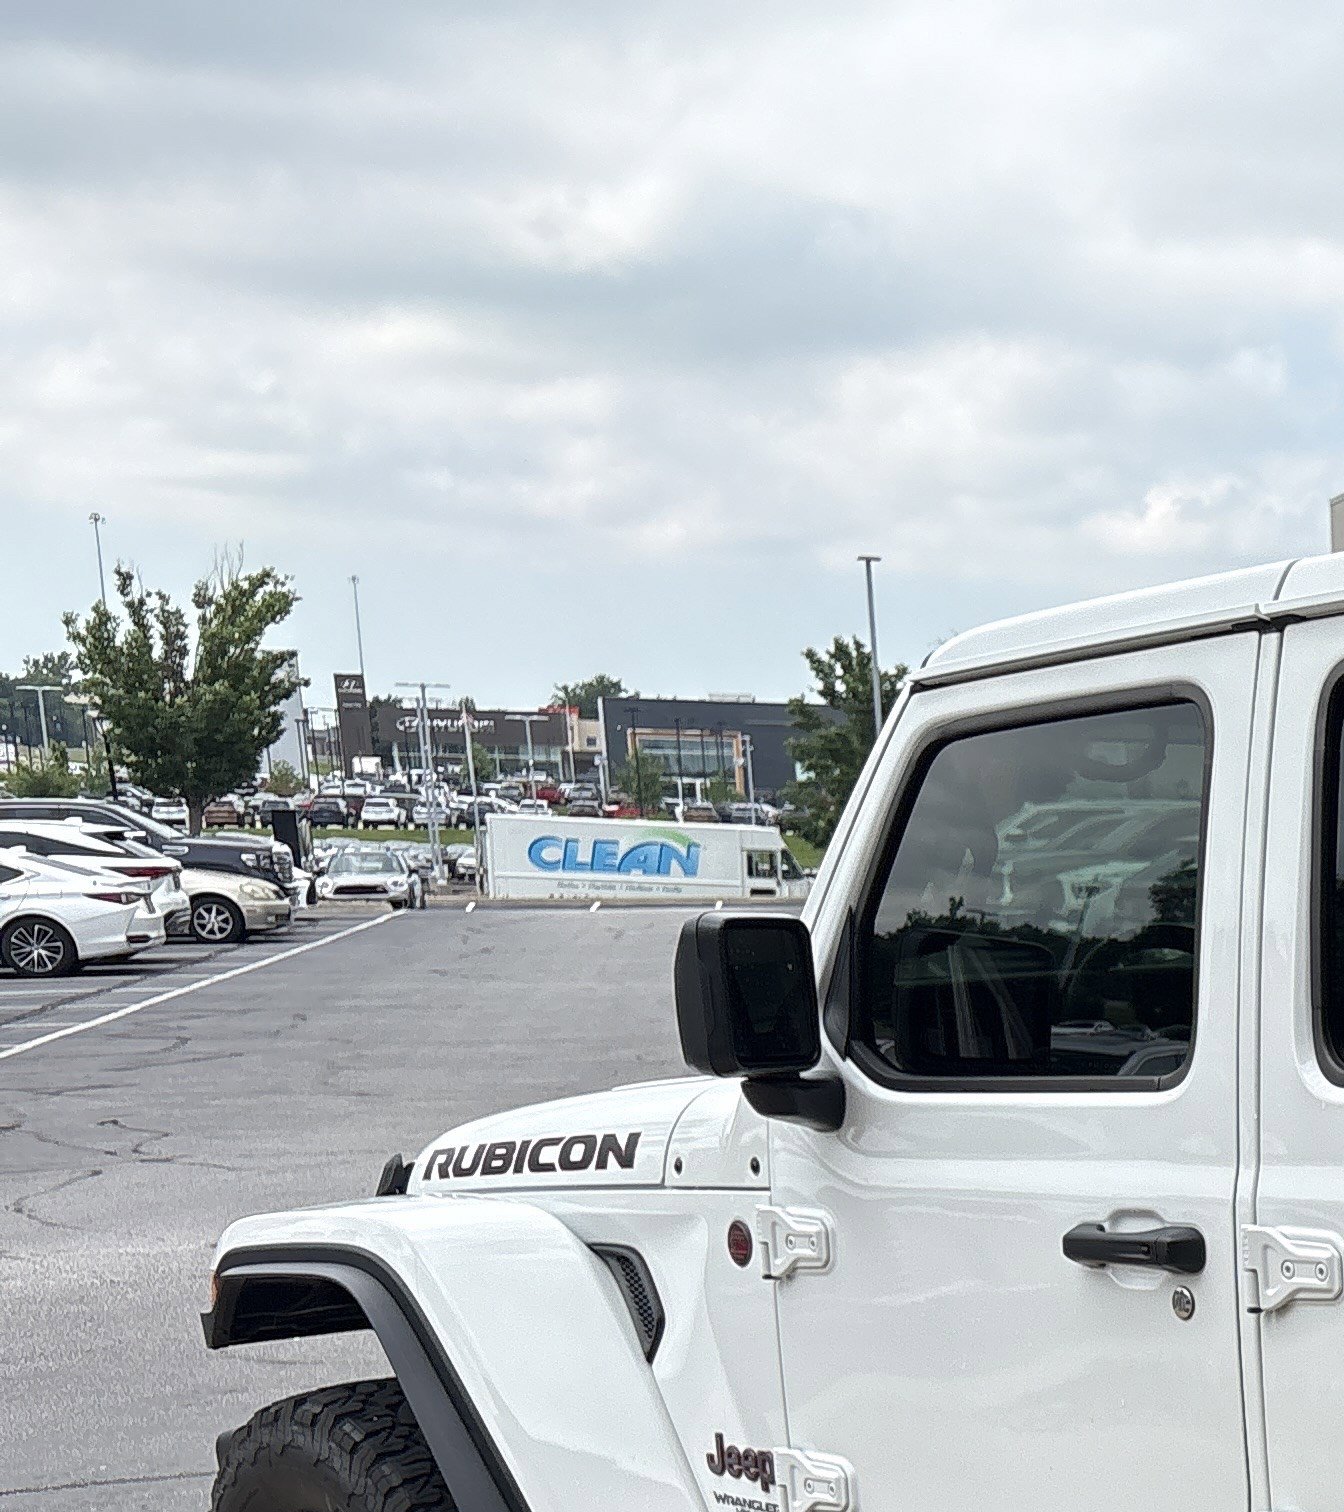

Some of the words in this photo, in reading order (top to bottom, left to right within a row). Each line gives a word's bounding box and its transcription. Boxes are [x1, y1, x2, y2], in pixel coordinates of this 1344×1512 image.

[527, 835, 700, 878] CLEAN
[421, 1131, 642, 1181] RUBICON
[706, 1432, 776, 1493] Jeep
